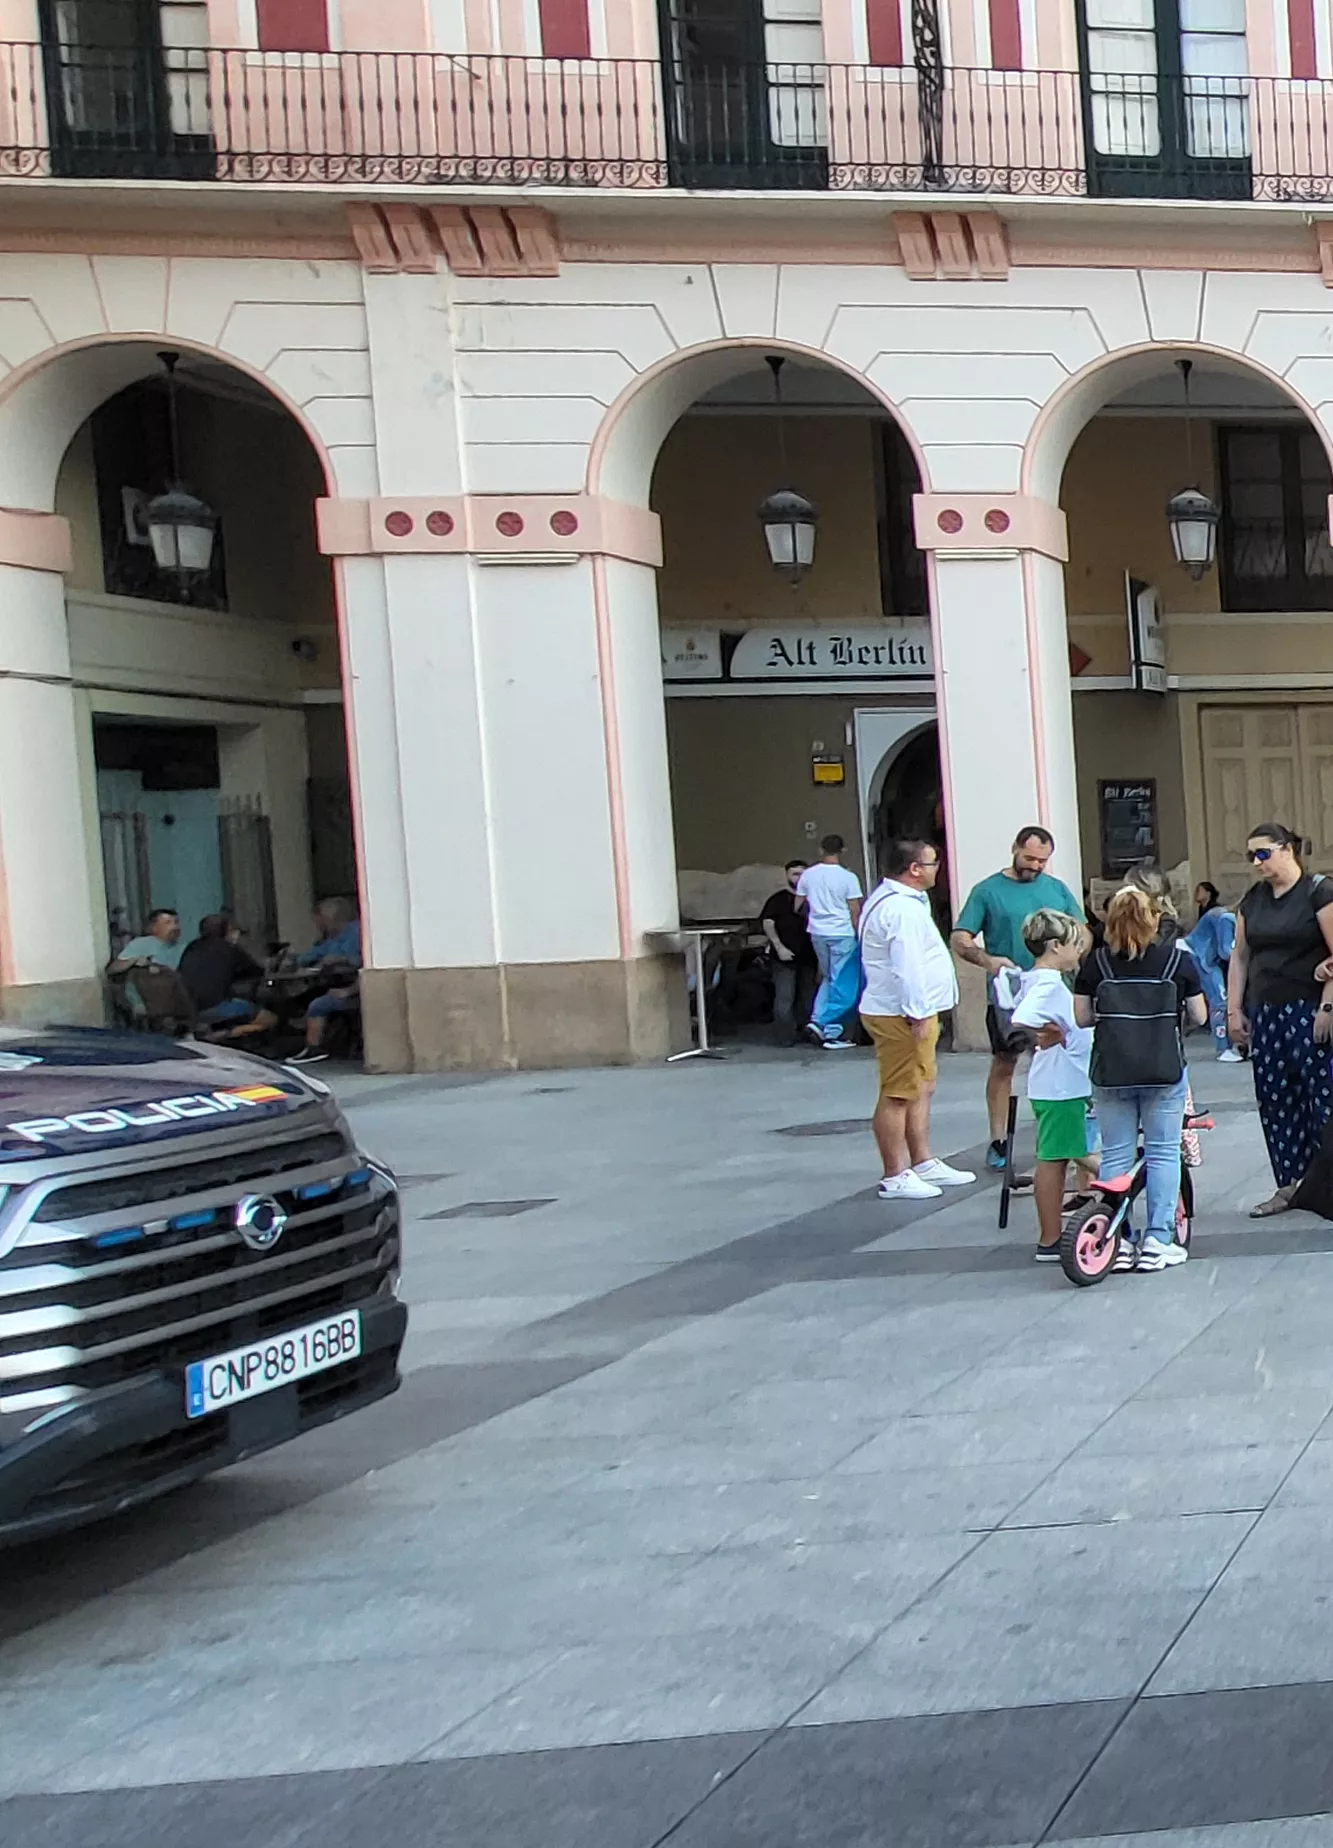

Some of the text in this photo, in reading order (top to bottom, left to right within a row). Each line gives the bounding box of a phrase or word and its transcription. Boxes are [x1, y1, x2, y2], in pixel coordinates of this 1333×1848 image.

[766, 637, 818, 667] Alt
[6, 1092, 256, 1142] POLICIA
[209, 1318, 356, 1400] CNP8816BB
